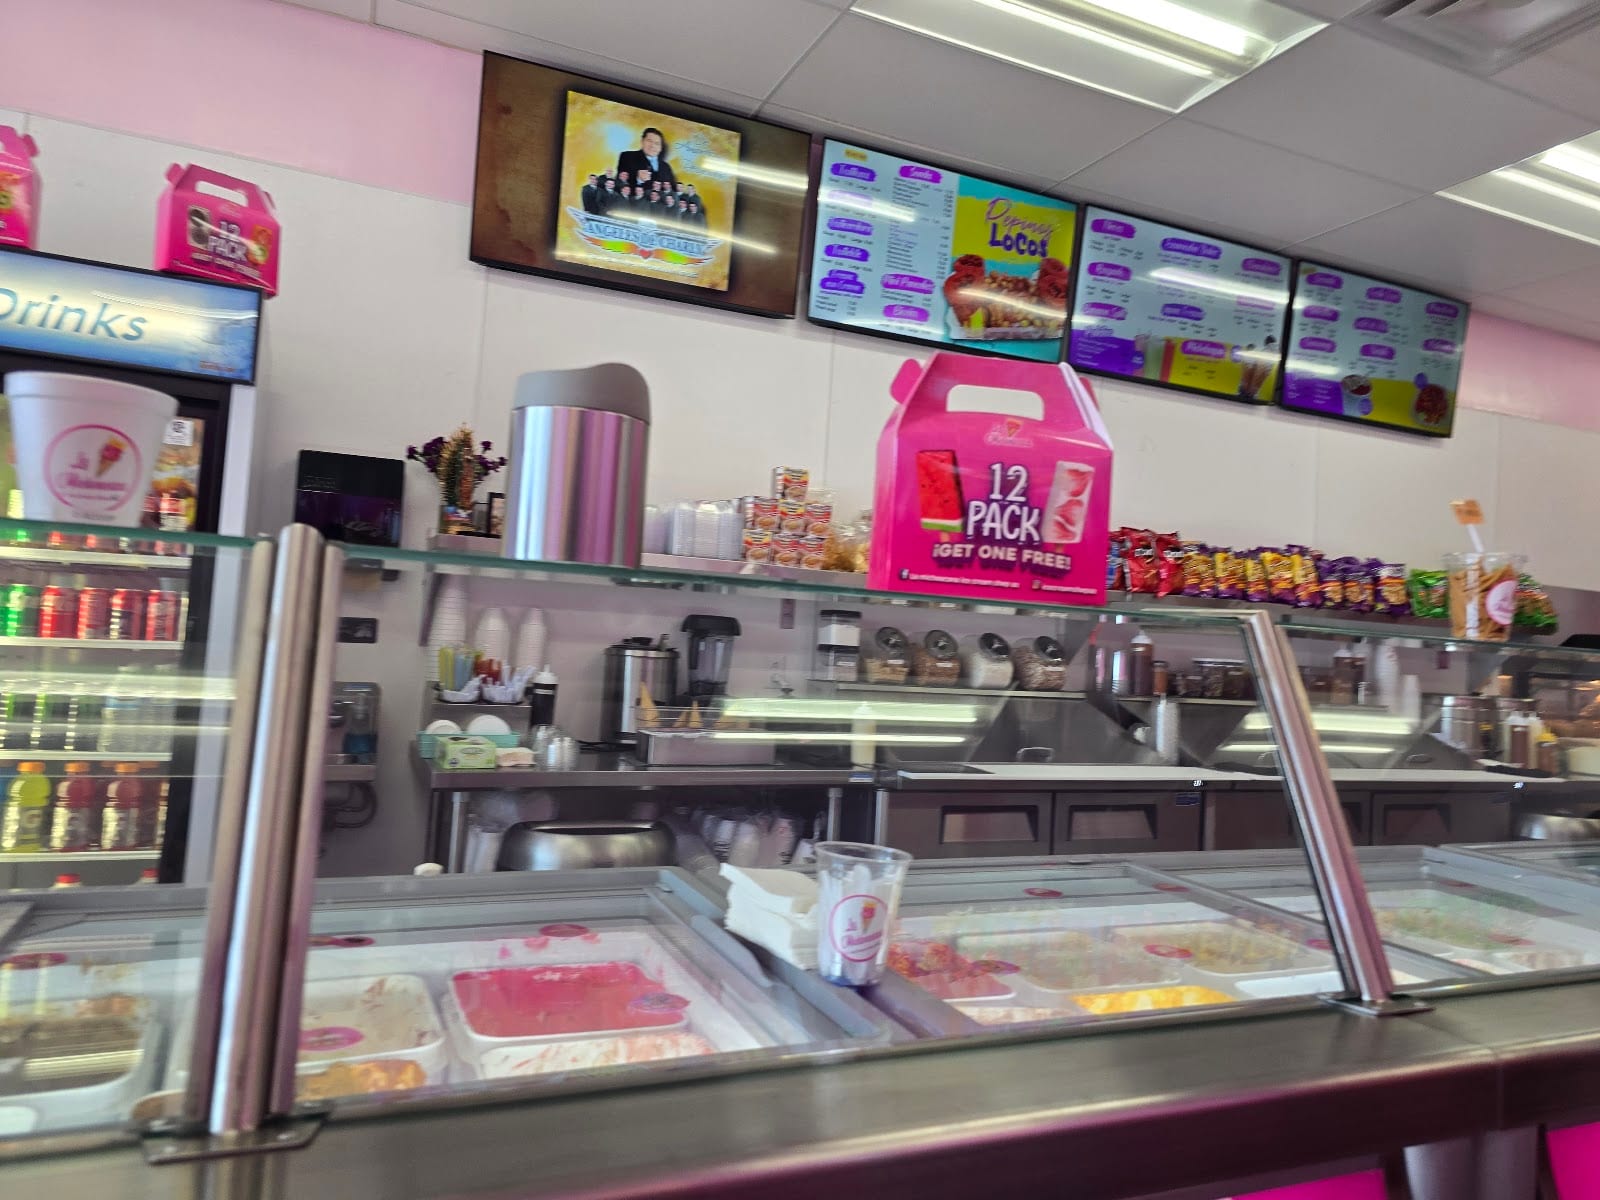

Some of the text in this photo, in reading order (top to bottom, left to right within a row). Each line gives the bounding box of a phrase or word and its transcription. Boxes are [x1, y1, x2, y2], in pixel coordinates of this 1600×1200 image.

[208, 235, 248, 263] PACK
[989, 463, 1028, 502] 12
[966, 500, 1041, 543] PACK
[978, 545, 1018, 561] ONE
[1021, 549, 1072, 570] FREE!
